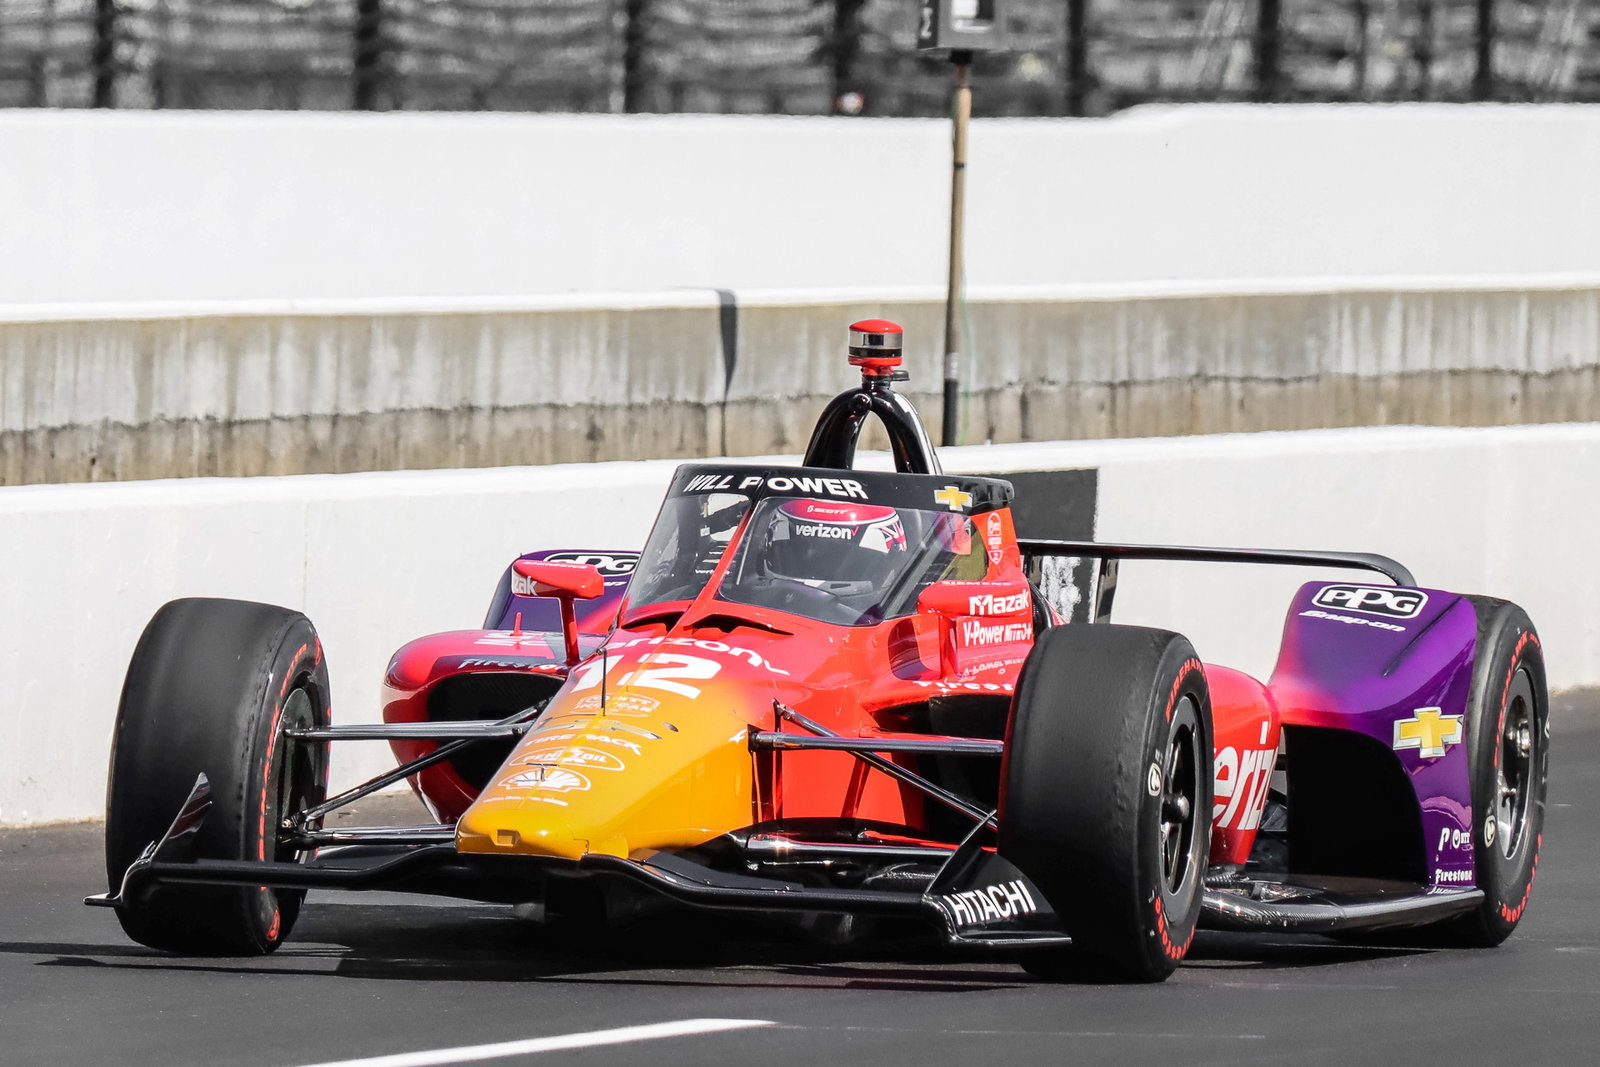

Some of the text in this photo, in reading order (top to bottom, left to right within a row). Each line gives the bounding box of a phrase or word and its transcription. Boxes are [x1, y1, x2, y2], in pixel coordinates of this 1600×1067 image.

[683, 474, 869, 499] WILL POWER
[795, 523, 851, 540] verizon
[968, 588, 1030, 616] Mazak
[1320, 588, 1420, 613] PPG
[963, 621, 1004, 647] V-Power
[570, 652, 722, 699] 12
[912, 680, 1014, 691] Firest
[1435, 868, 1472, 885] Firestone
[943, 880, 1037, 926] HITACHI
